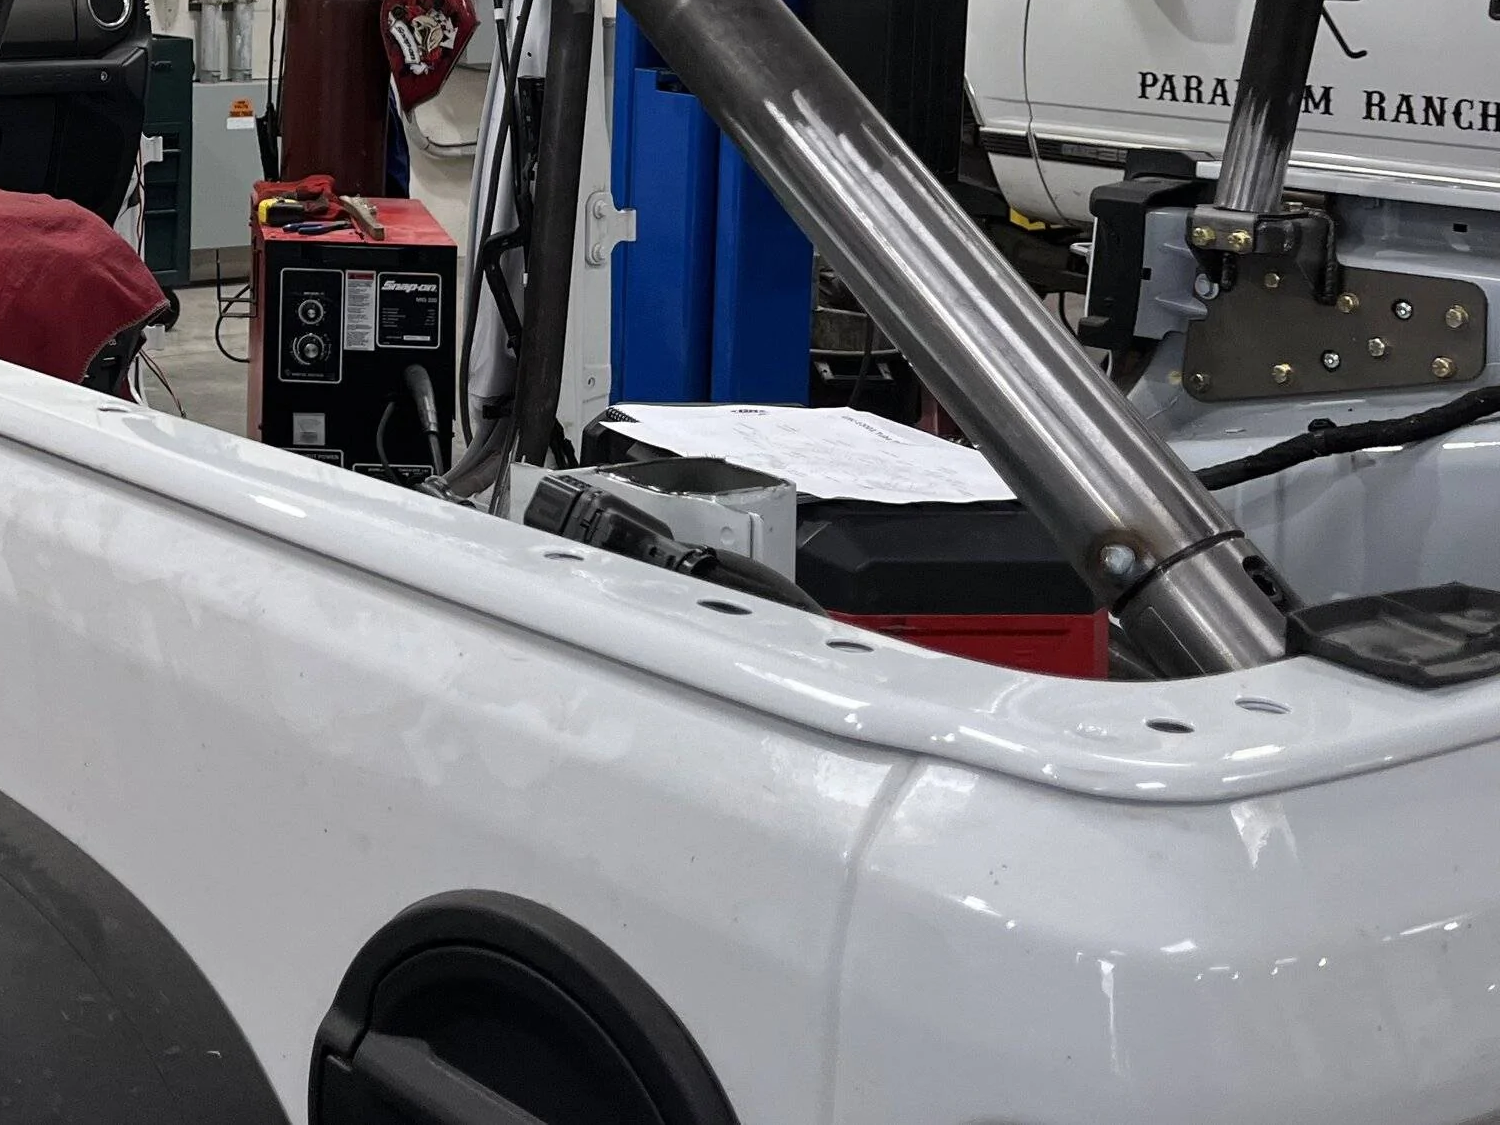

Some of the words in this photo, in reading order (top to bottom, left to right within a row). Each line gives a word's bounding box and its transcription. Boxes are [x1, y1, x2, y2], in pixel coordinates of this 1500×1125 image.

[1138, 71, 1334, 116] PARAM
[1362, 89, 1500, 133] RANCH
[381, 280, 437, 293] Snap-on
